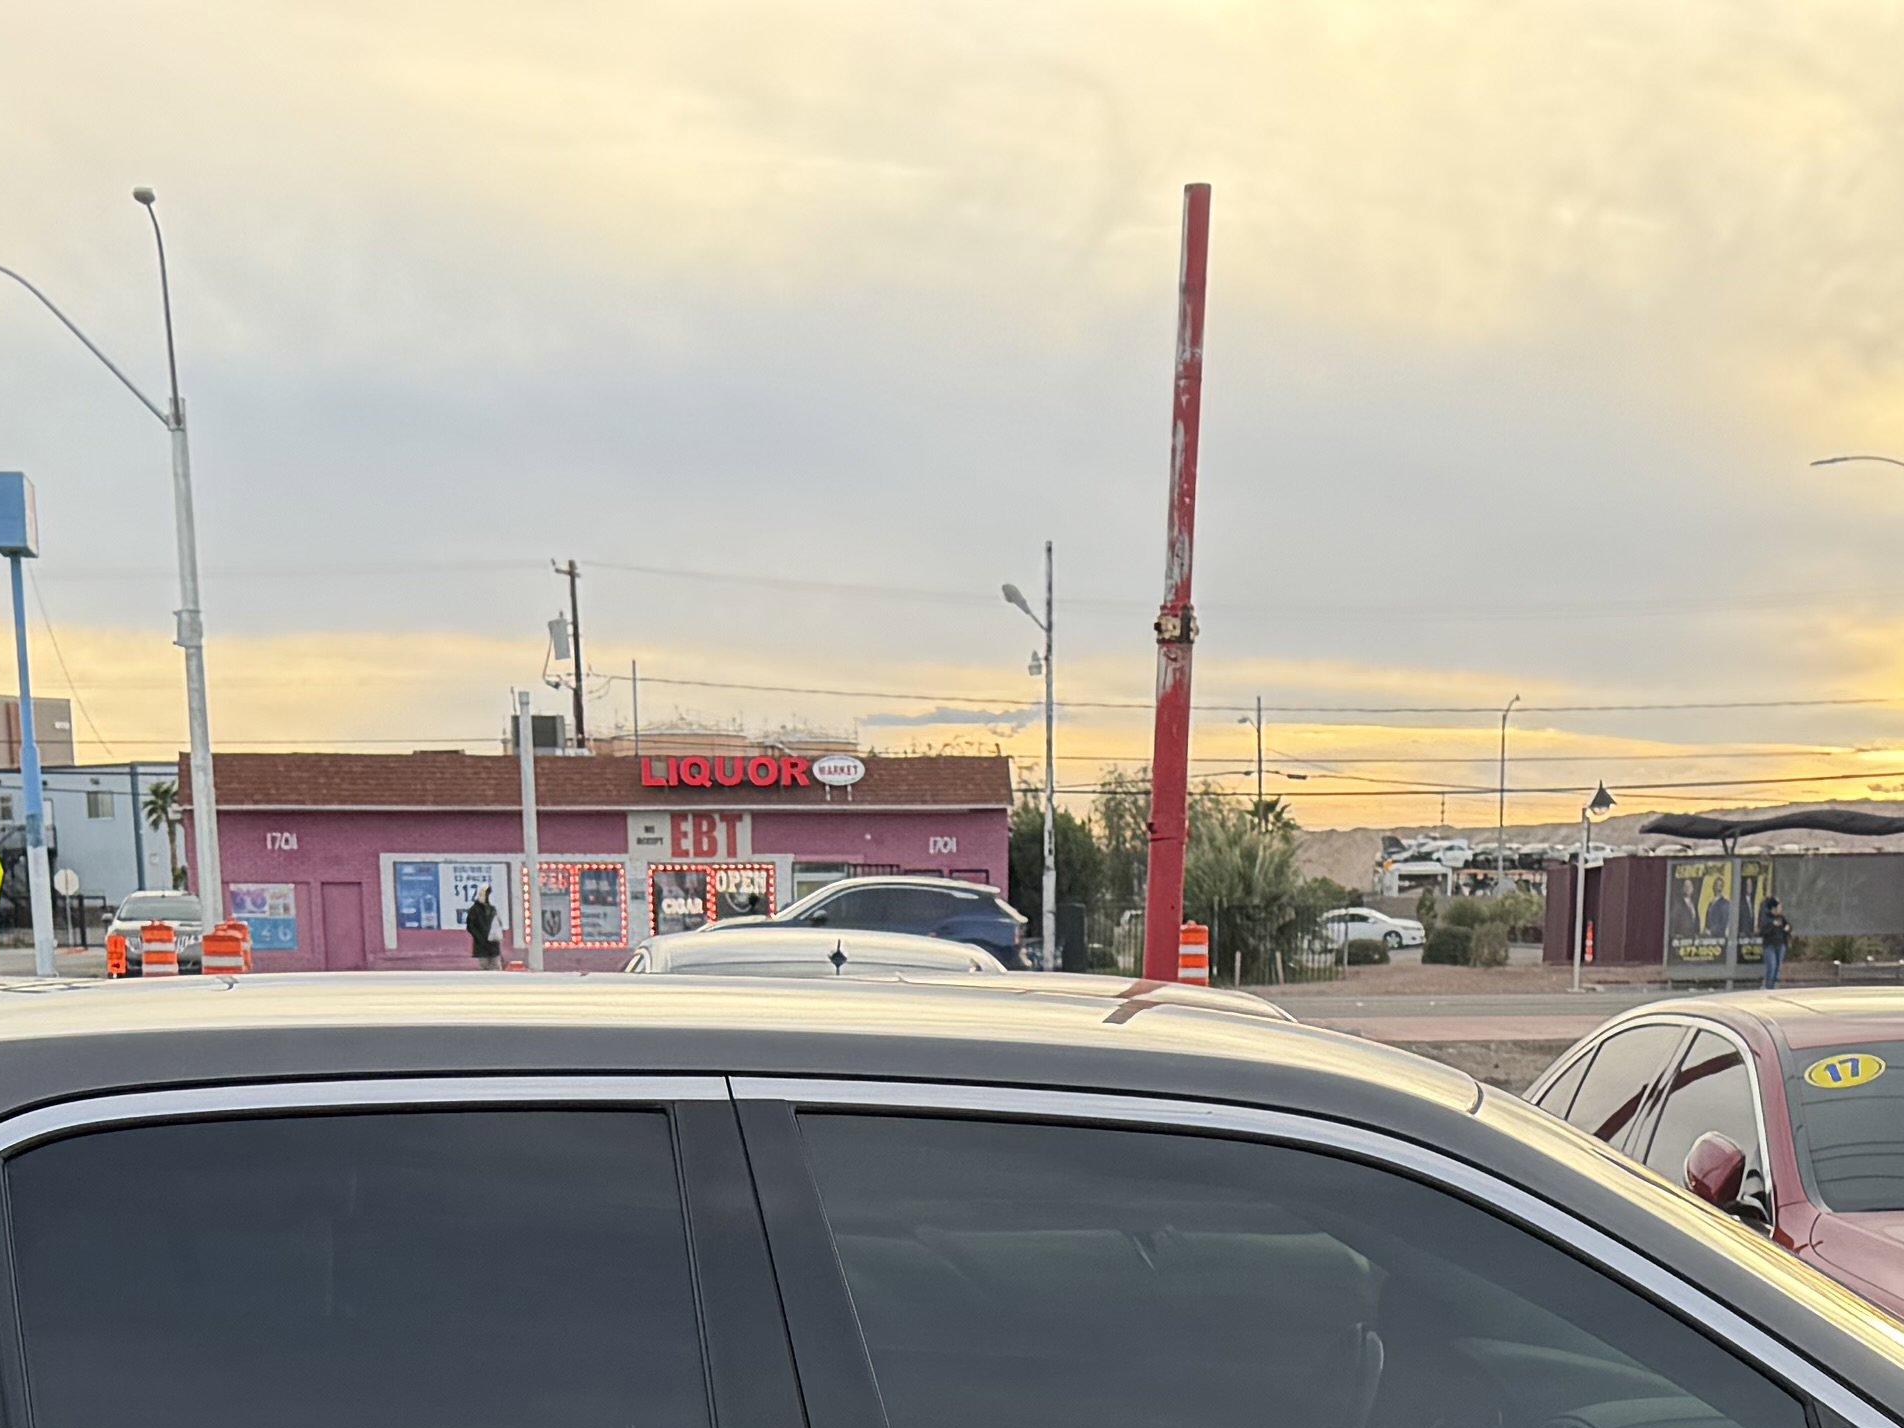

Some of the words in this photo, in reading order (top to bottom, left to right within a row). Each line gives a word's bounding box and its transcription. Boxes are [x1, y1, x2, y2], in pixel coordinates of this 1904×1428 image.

[640, 755, 812, 788] LIQUOR
[818, 764, 859, 776] MARKET
[671, 813, 744, 858] EBT
[716, 869, 767, 894] OPEN
[1824, 1057, 1859, 1083] 17
